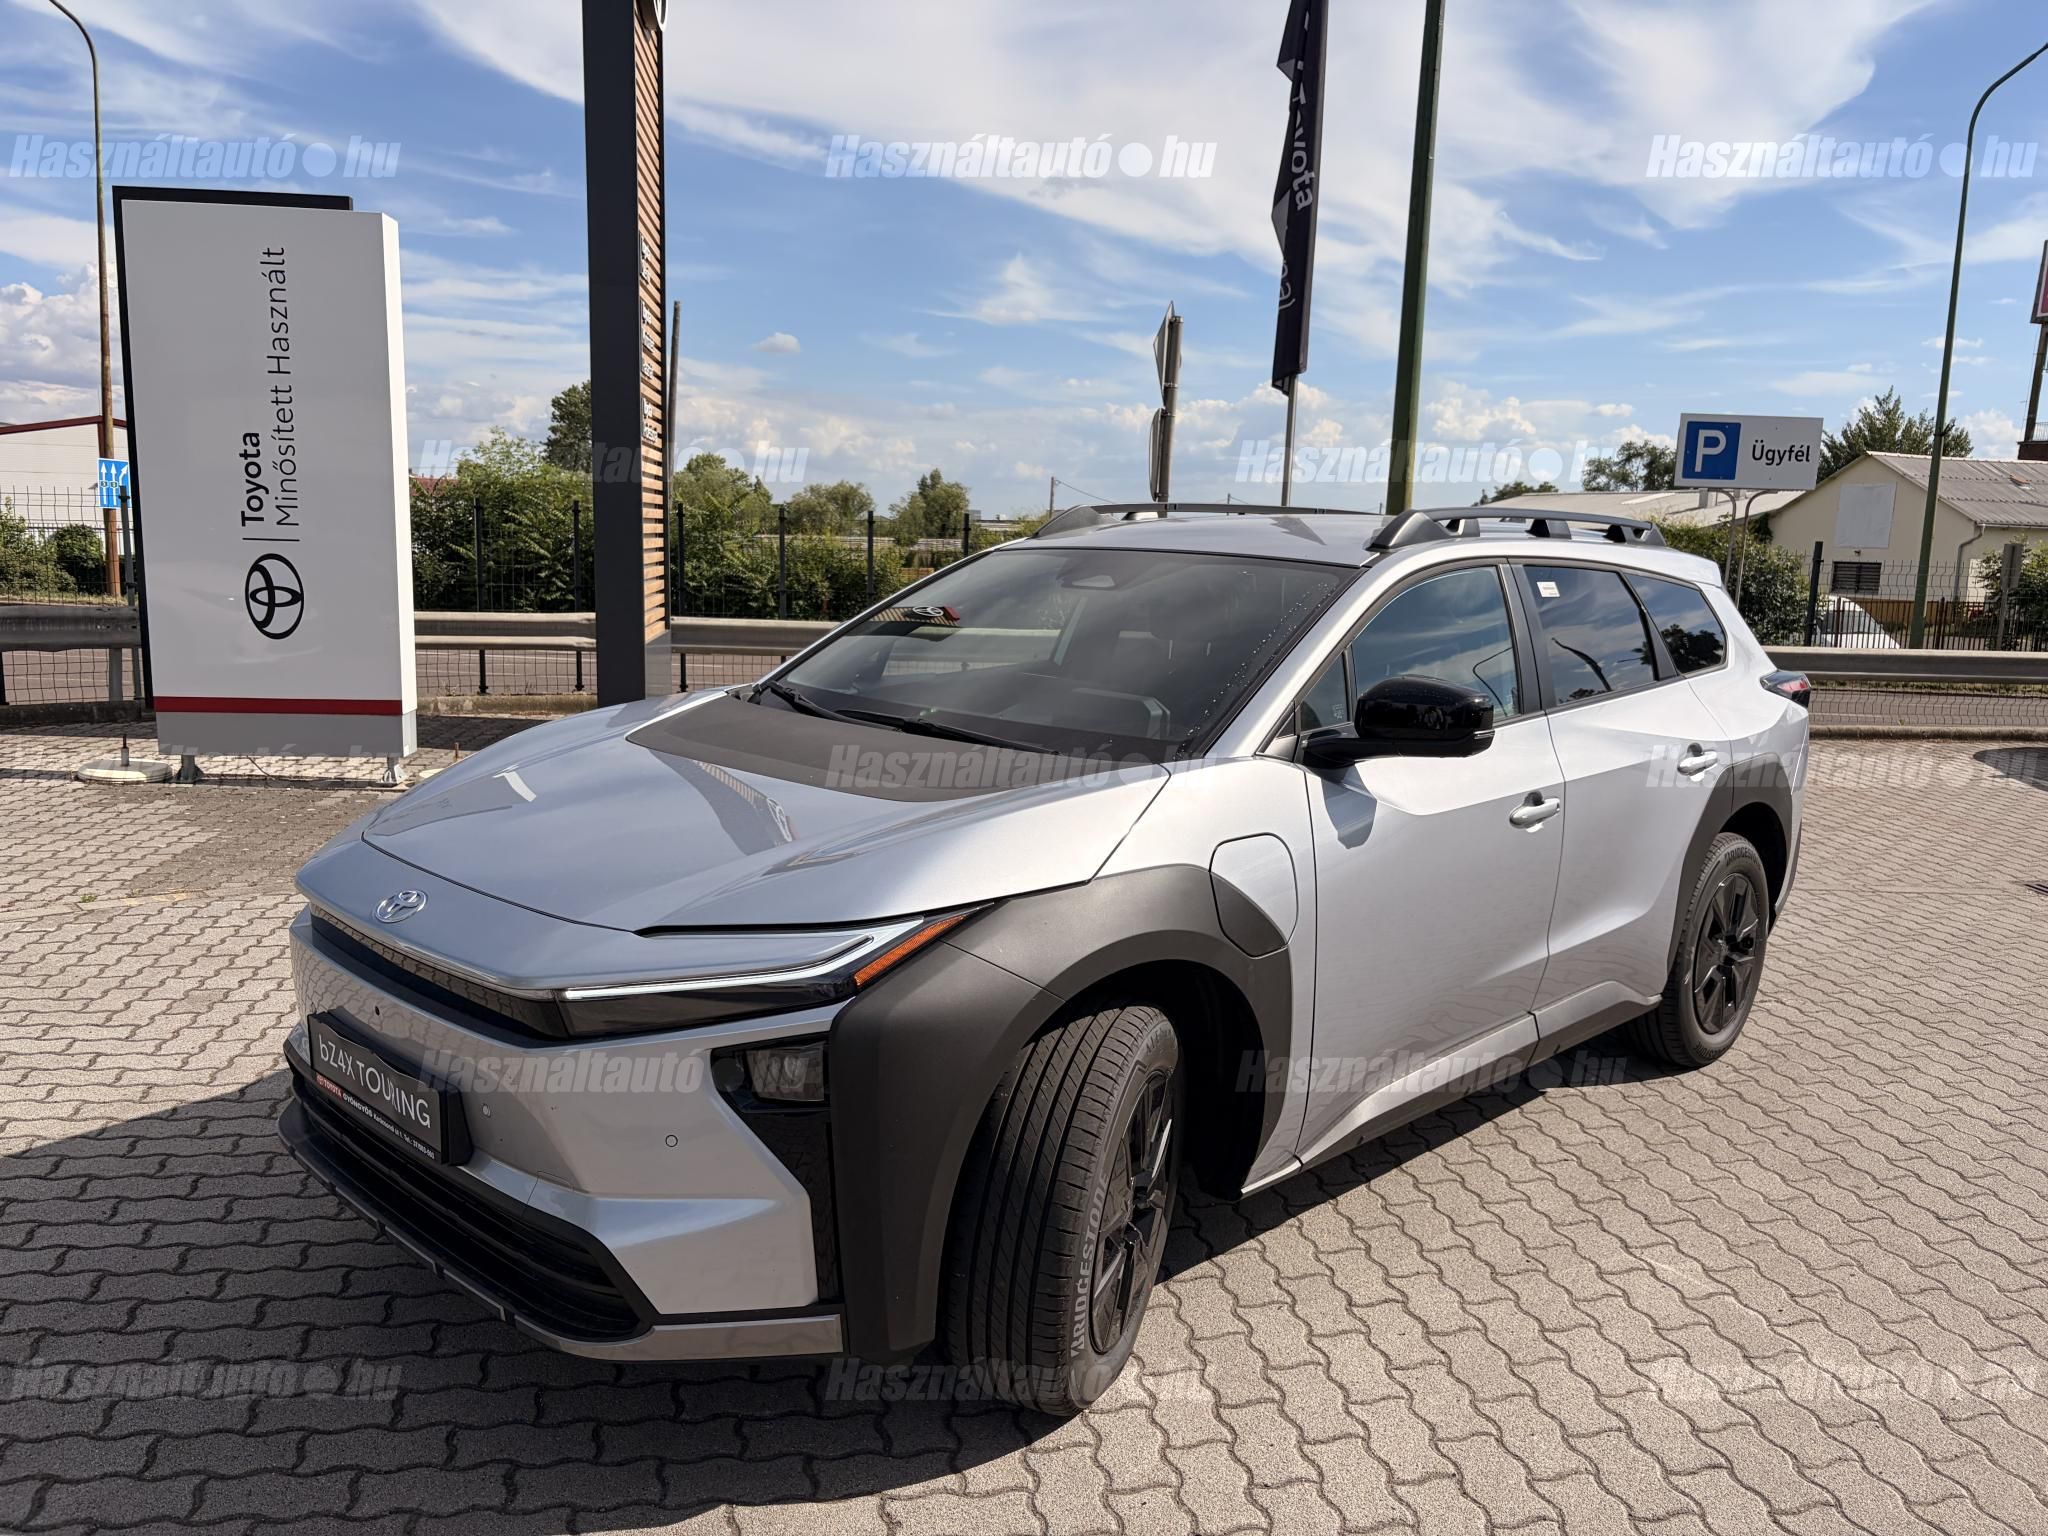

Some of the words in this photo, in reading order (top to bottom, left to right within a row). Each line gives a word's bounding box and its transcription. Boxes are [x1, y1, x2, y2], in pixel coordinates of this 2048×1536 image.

[259, 247, 292, 375] Használt
[238, 432, 270, 527] Toyota
[270, 384, 300, 526] Minősített
[1694, 429, 1727, 473] P
[1751, 439, 1811, 466] Ügyfél
[319, 1034, 355, 1080] bZ4X
